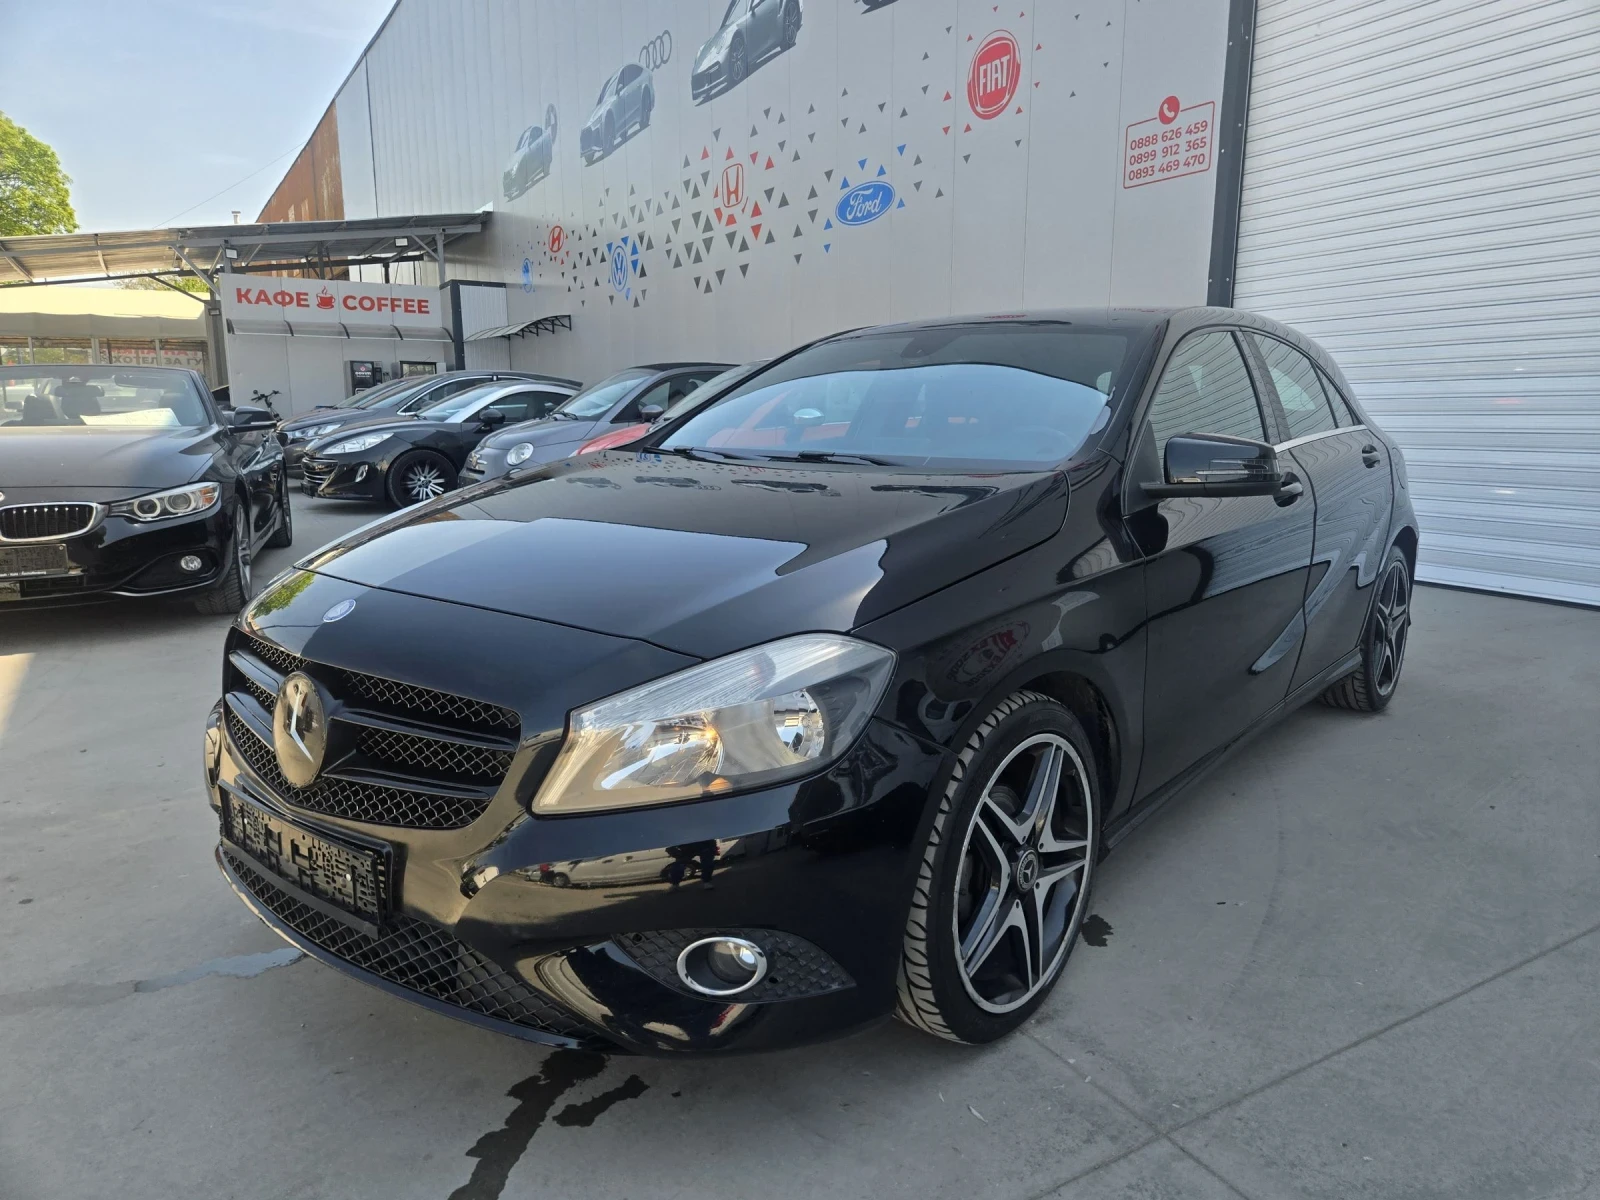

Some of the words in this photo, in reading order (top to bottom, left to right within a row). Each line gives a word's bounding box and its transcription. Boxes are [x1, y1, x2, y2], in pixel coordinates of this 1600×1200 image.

[980, 55, 1010, 96] FIAT
[1130, 134, 1158, 151] 0888
[1161, 127, 1182, 142] 626
[1185, 120, 1208, 135] 459
[1129, 149, 1157, 166] 0899
[1161, 143, 1180, 158] 912
[1184, 136, 1207, 152] 365
[1128, 165, 1155, 181] 0893
[1158, 159, 1180, 174] 469
[1183, 153, 1205, 168] 470
[846, 188, 883, 220] Ford
[236, 287, 310, 308] КАФЕ
[342, 295, 430, 314] COFFEE
